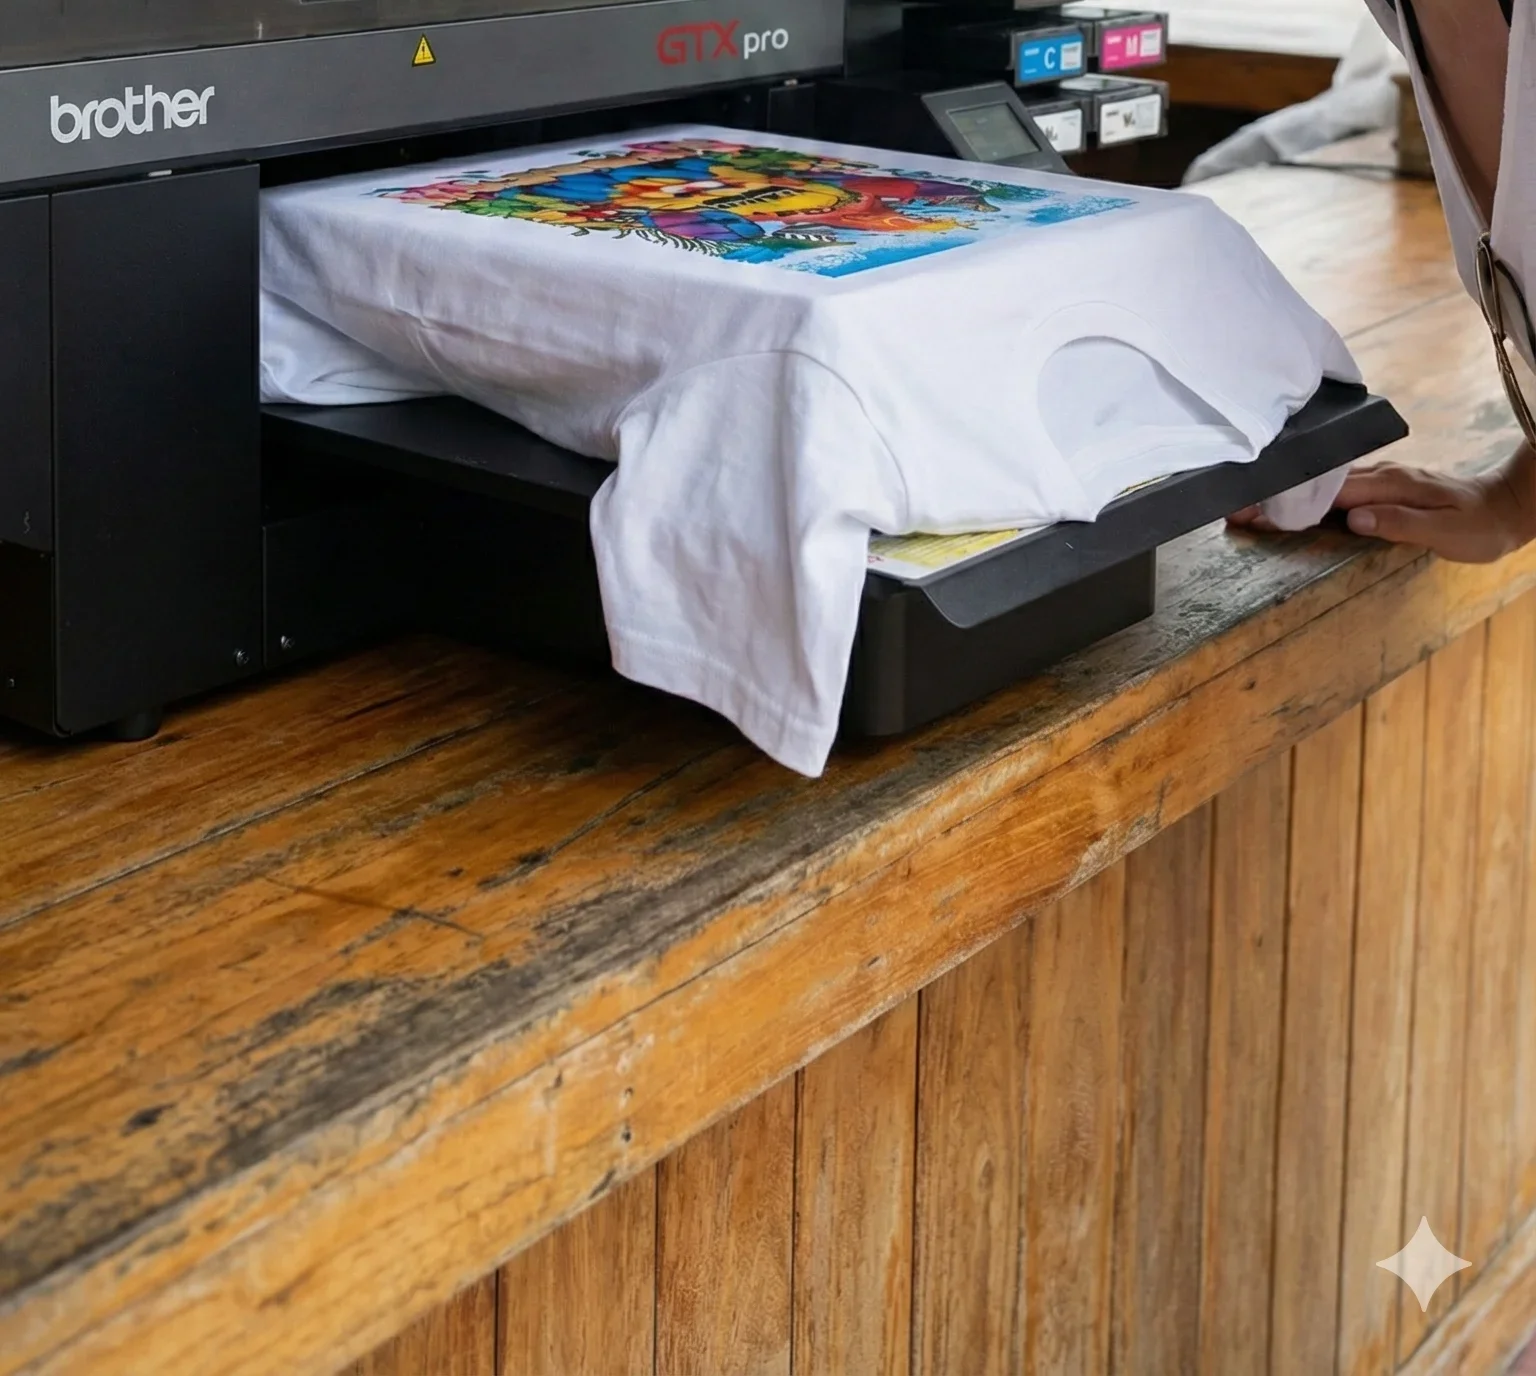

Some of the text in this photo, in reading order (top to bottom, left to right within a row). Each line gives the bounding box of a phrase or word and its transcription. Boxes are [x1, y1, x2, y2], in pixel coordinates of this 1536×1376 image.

[656, 18, 789, 65] GTX pro
[1044, 46, 1057, 70] C
[1125, 34, 1139, 58] M
[50, 84, 216, 144] brother
